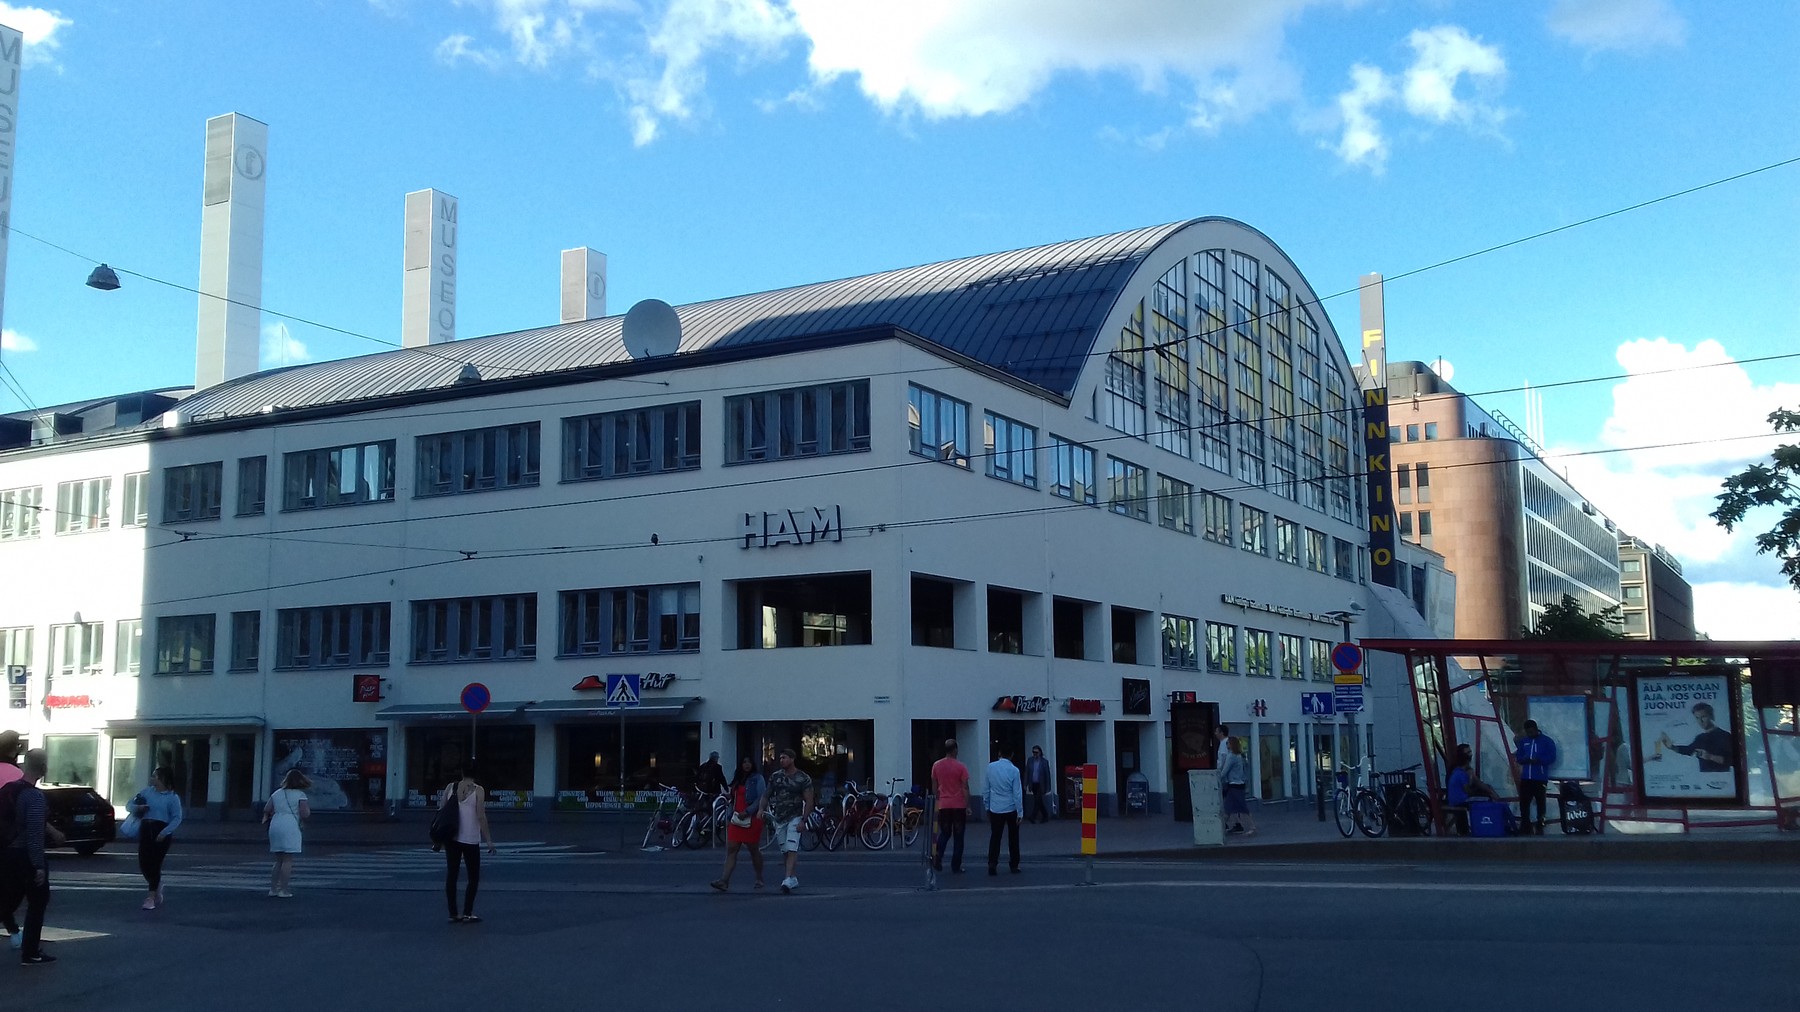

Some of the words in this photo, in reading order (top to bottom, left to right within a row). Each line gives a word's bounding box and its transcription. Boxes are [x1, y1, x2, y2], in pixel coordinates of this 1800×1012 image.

[1363, 329, 1391, 566] FINNKINO
[737, 505, 842, 549] HAM
[12, 666, 24, 683] P
[642, 673, 675, 689] Hut
[1643, 682, 1663, 692] ÄLÄ
[1666, 683, 1720, 691] KOSKAAN
[1670, 692, 1689, 700] JOS
[1015, 697, 1035, 713] Pizza
[1643, 701, 1686, 710] JUONUT
